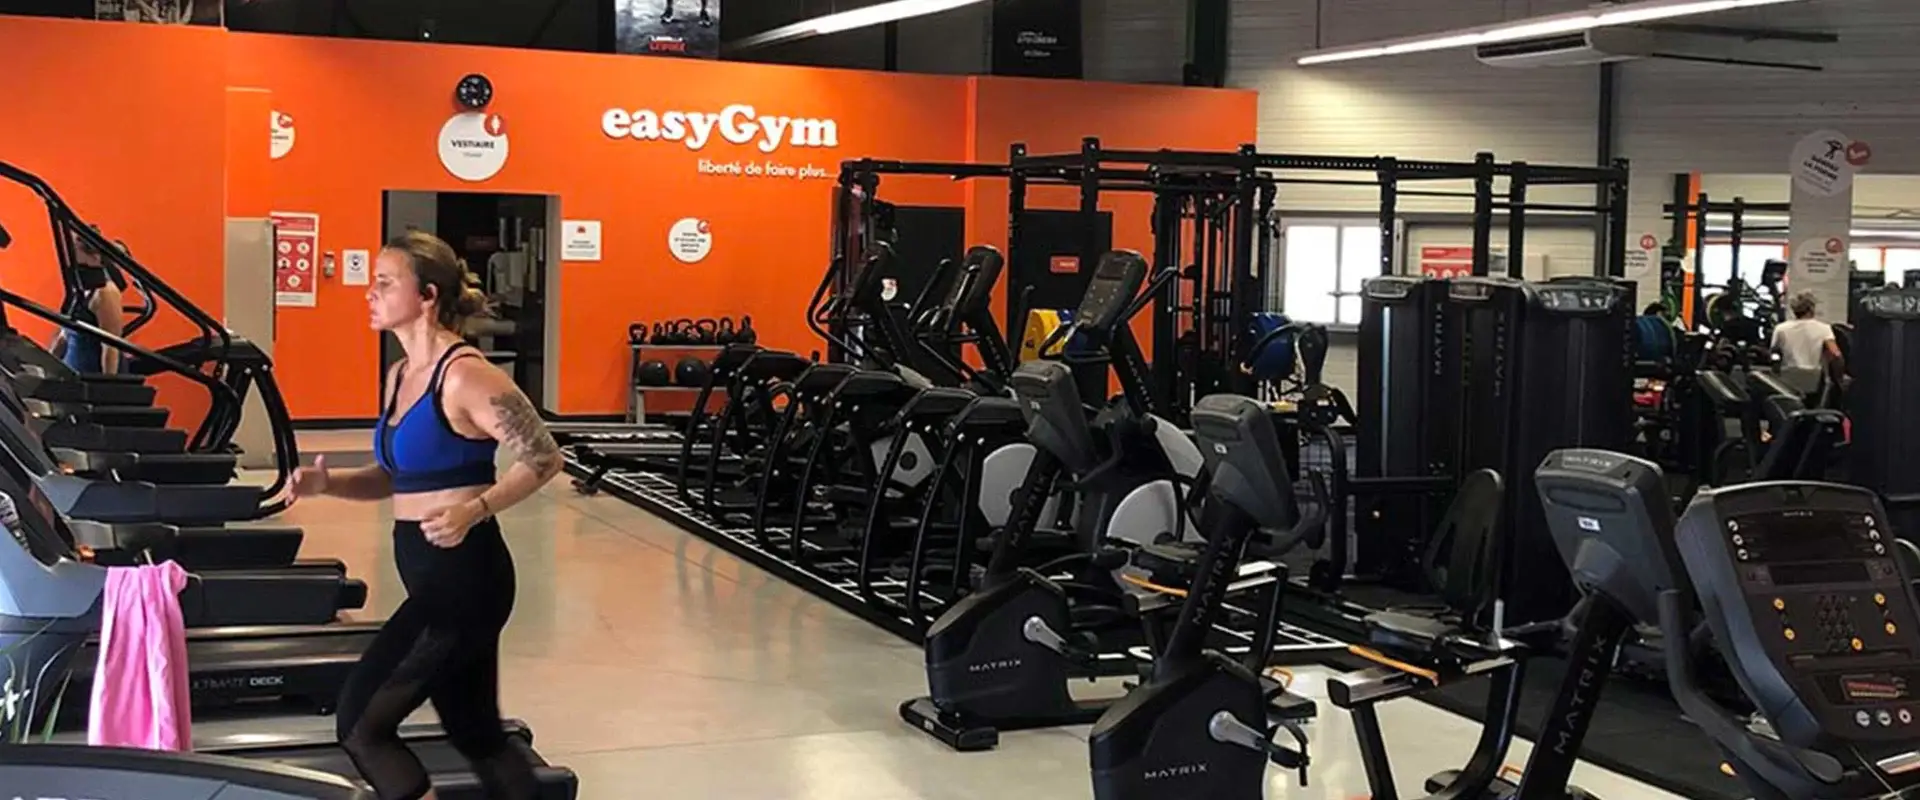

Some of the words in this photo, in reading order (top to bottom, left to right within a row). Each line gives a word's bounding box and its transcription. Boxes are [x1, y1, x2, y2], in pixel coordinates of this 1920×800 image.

[451, 140, 495, 149] VESTIAIRE
[602, 104, 838, 152] easyGym
[698, 159, 742, 175] liberté
[745, 161, 763, 175] de
[765, 160, 797, 177] faire
[1434, 303, 1442, 375] MATRIX
[1494, 312, 1505, 396] MATRIX
[1010, 474, 1047, 548] MATRIX
[1192, 535, 1236, 625] MATRIX
[250, 675, 284, 686] DECK
[969, 660, 1021, 672] MATRIX
[1553, 635, 1607, 754] MATRIX
[1144, 762, 1208, 780] MATRIX
